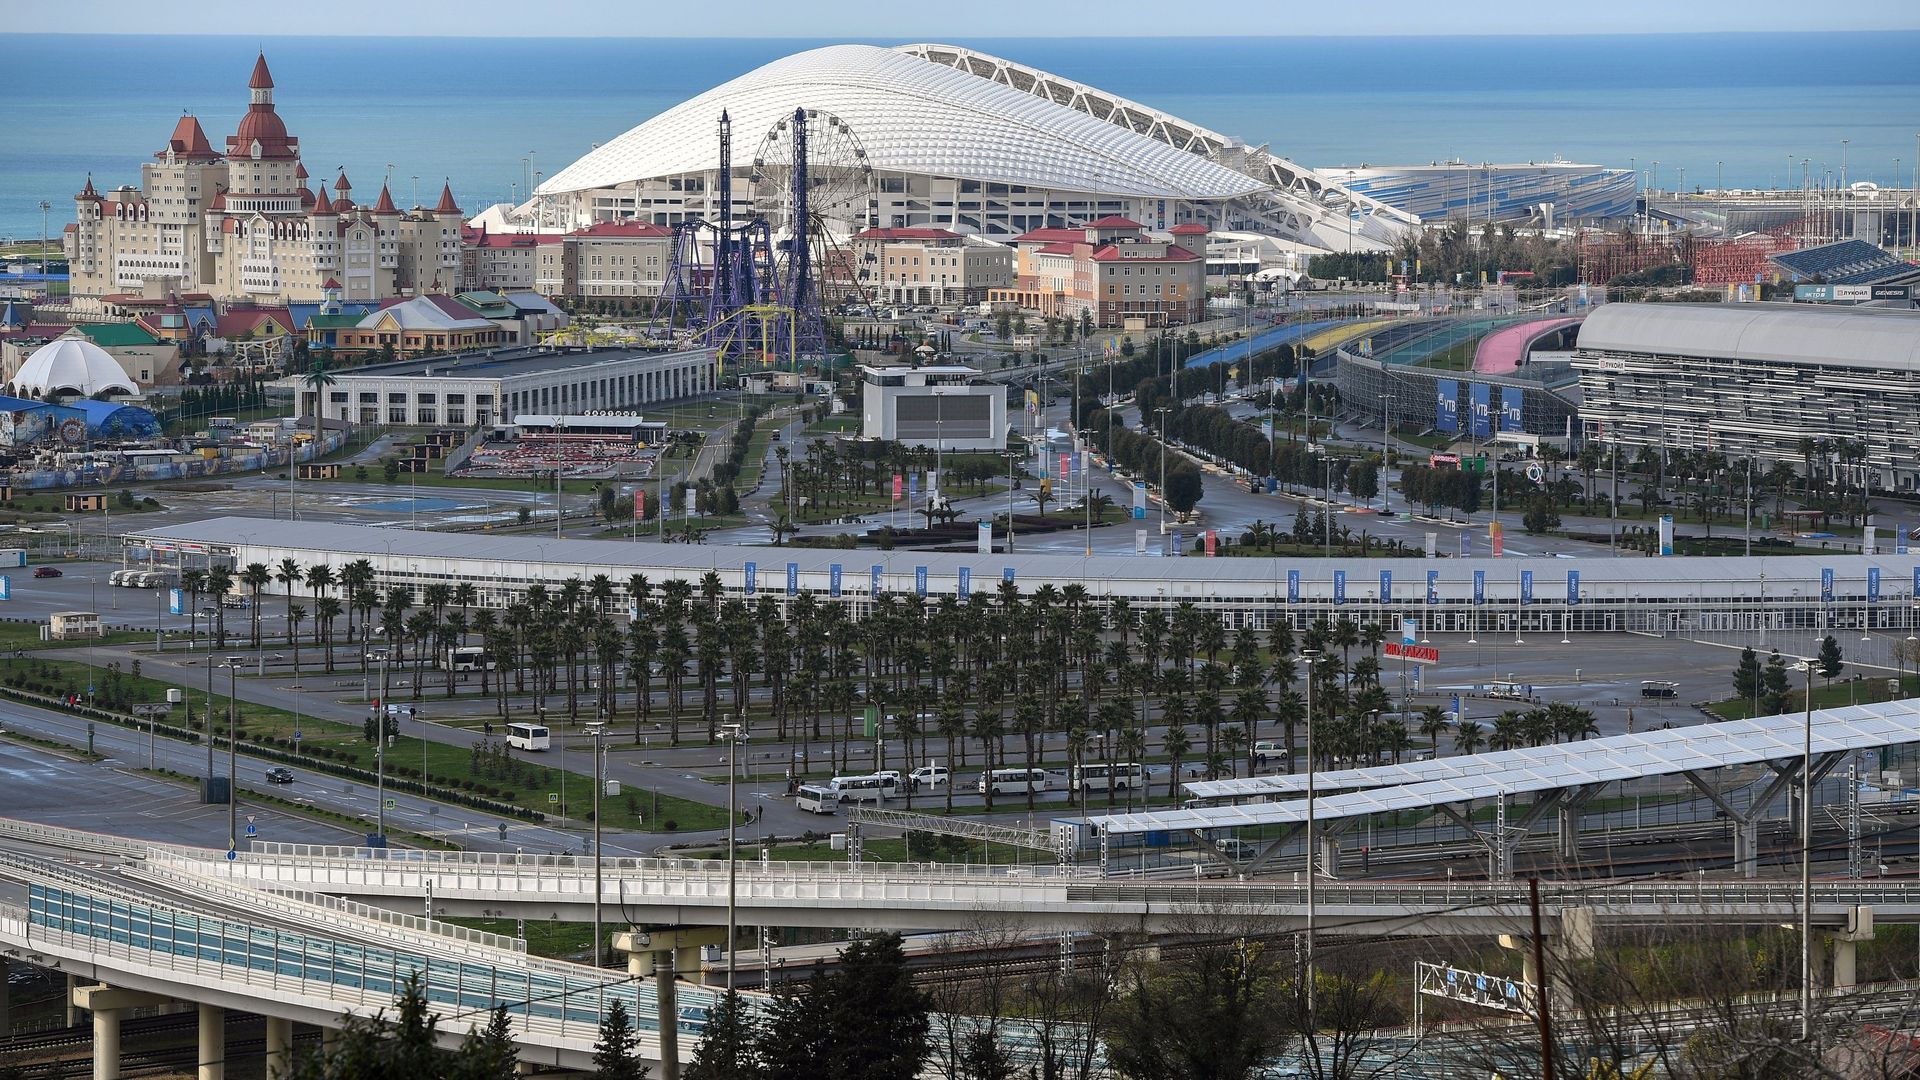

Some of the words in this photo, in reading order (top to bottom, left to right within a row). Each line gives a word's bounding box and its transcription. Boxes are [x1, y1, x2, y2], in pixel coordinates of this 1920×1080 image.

[1444, 399, 1456, 412] VTB
[1476, 403, 1488, 416] VTB
[1508, 408, 1521, 420] VTB
